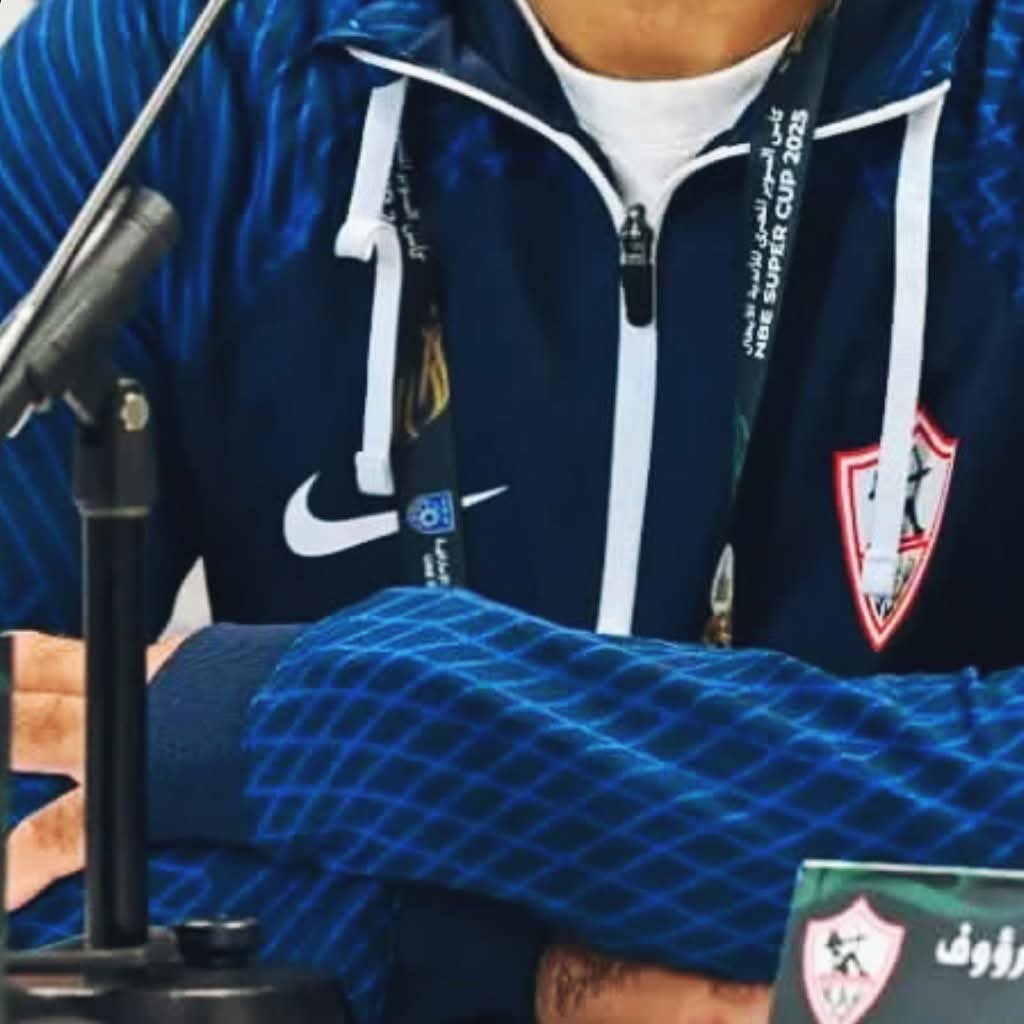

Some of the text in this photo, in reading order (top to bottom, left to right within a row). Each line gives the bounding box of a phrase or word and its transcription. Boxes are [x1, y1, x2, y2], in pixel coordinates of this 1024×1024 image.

[754, 109, 809, 360] NBE SUPER CUP 2025
